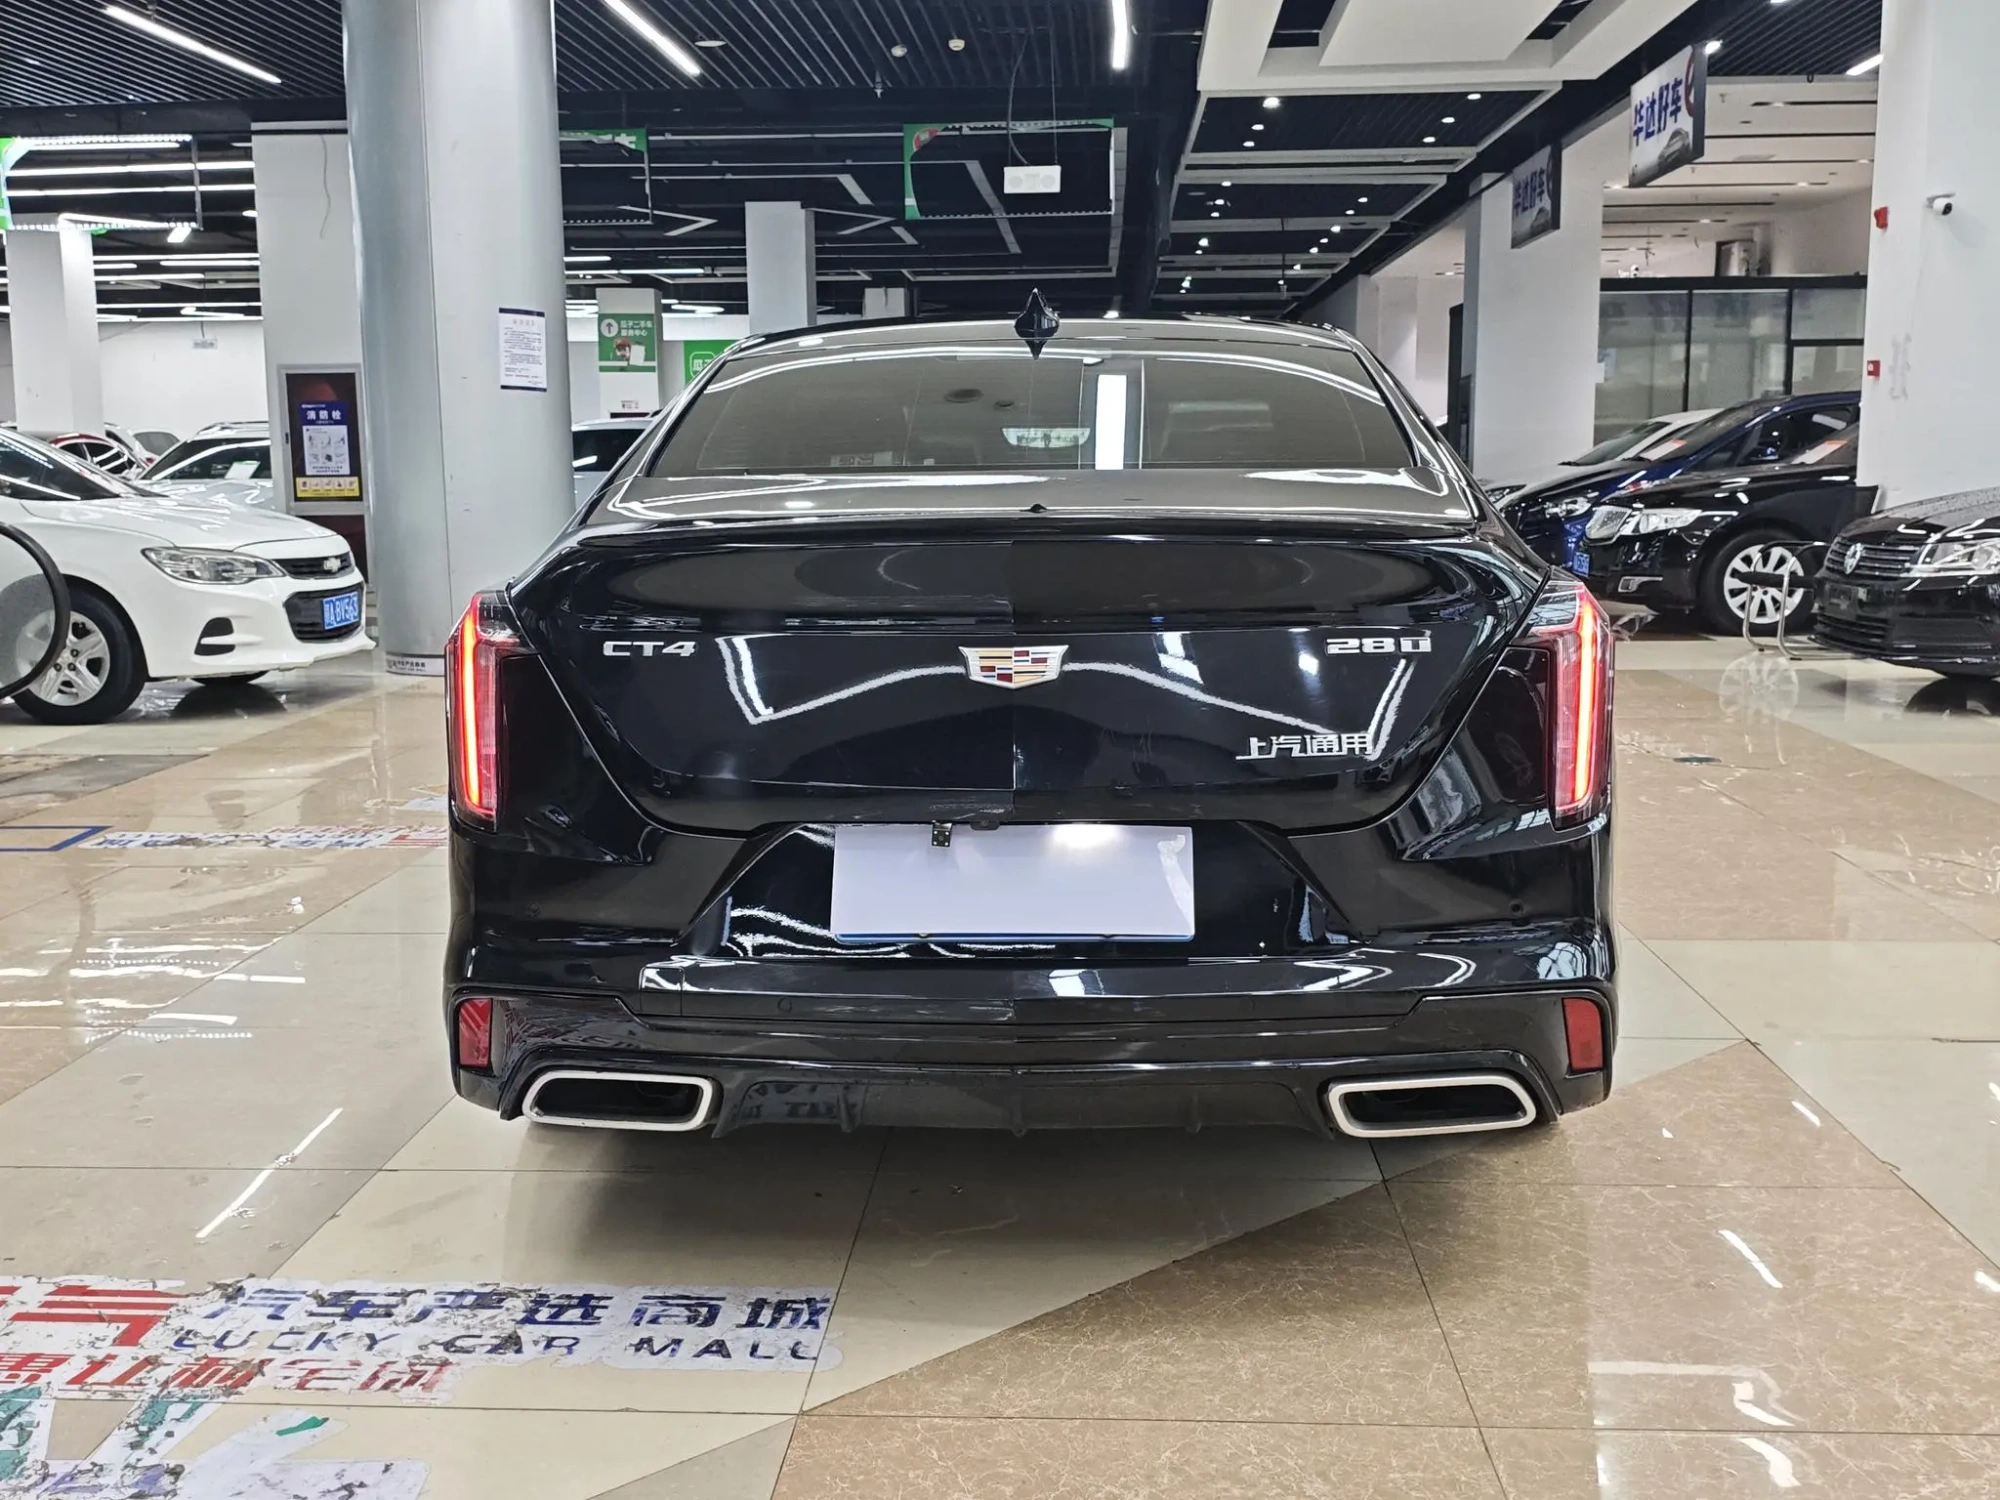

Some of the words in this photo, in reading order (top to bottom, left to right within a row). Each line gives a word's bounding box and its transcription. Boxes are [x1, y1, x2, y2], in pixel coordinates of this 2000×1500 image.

[1632, 77, 1684, 147] 华达好车
[1514, 166, 1546, 217] 华达好车
[603, 641, 697, 656] CT4
[1325, 637, 1432, 655] 28T
[1235, 733, 1375, 760] 上汽通用
[172, 1329, 401, 1351] LUCKY
[626, 1335, 819, 1361] MALL
